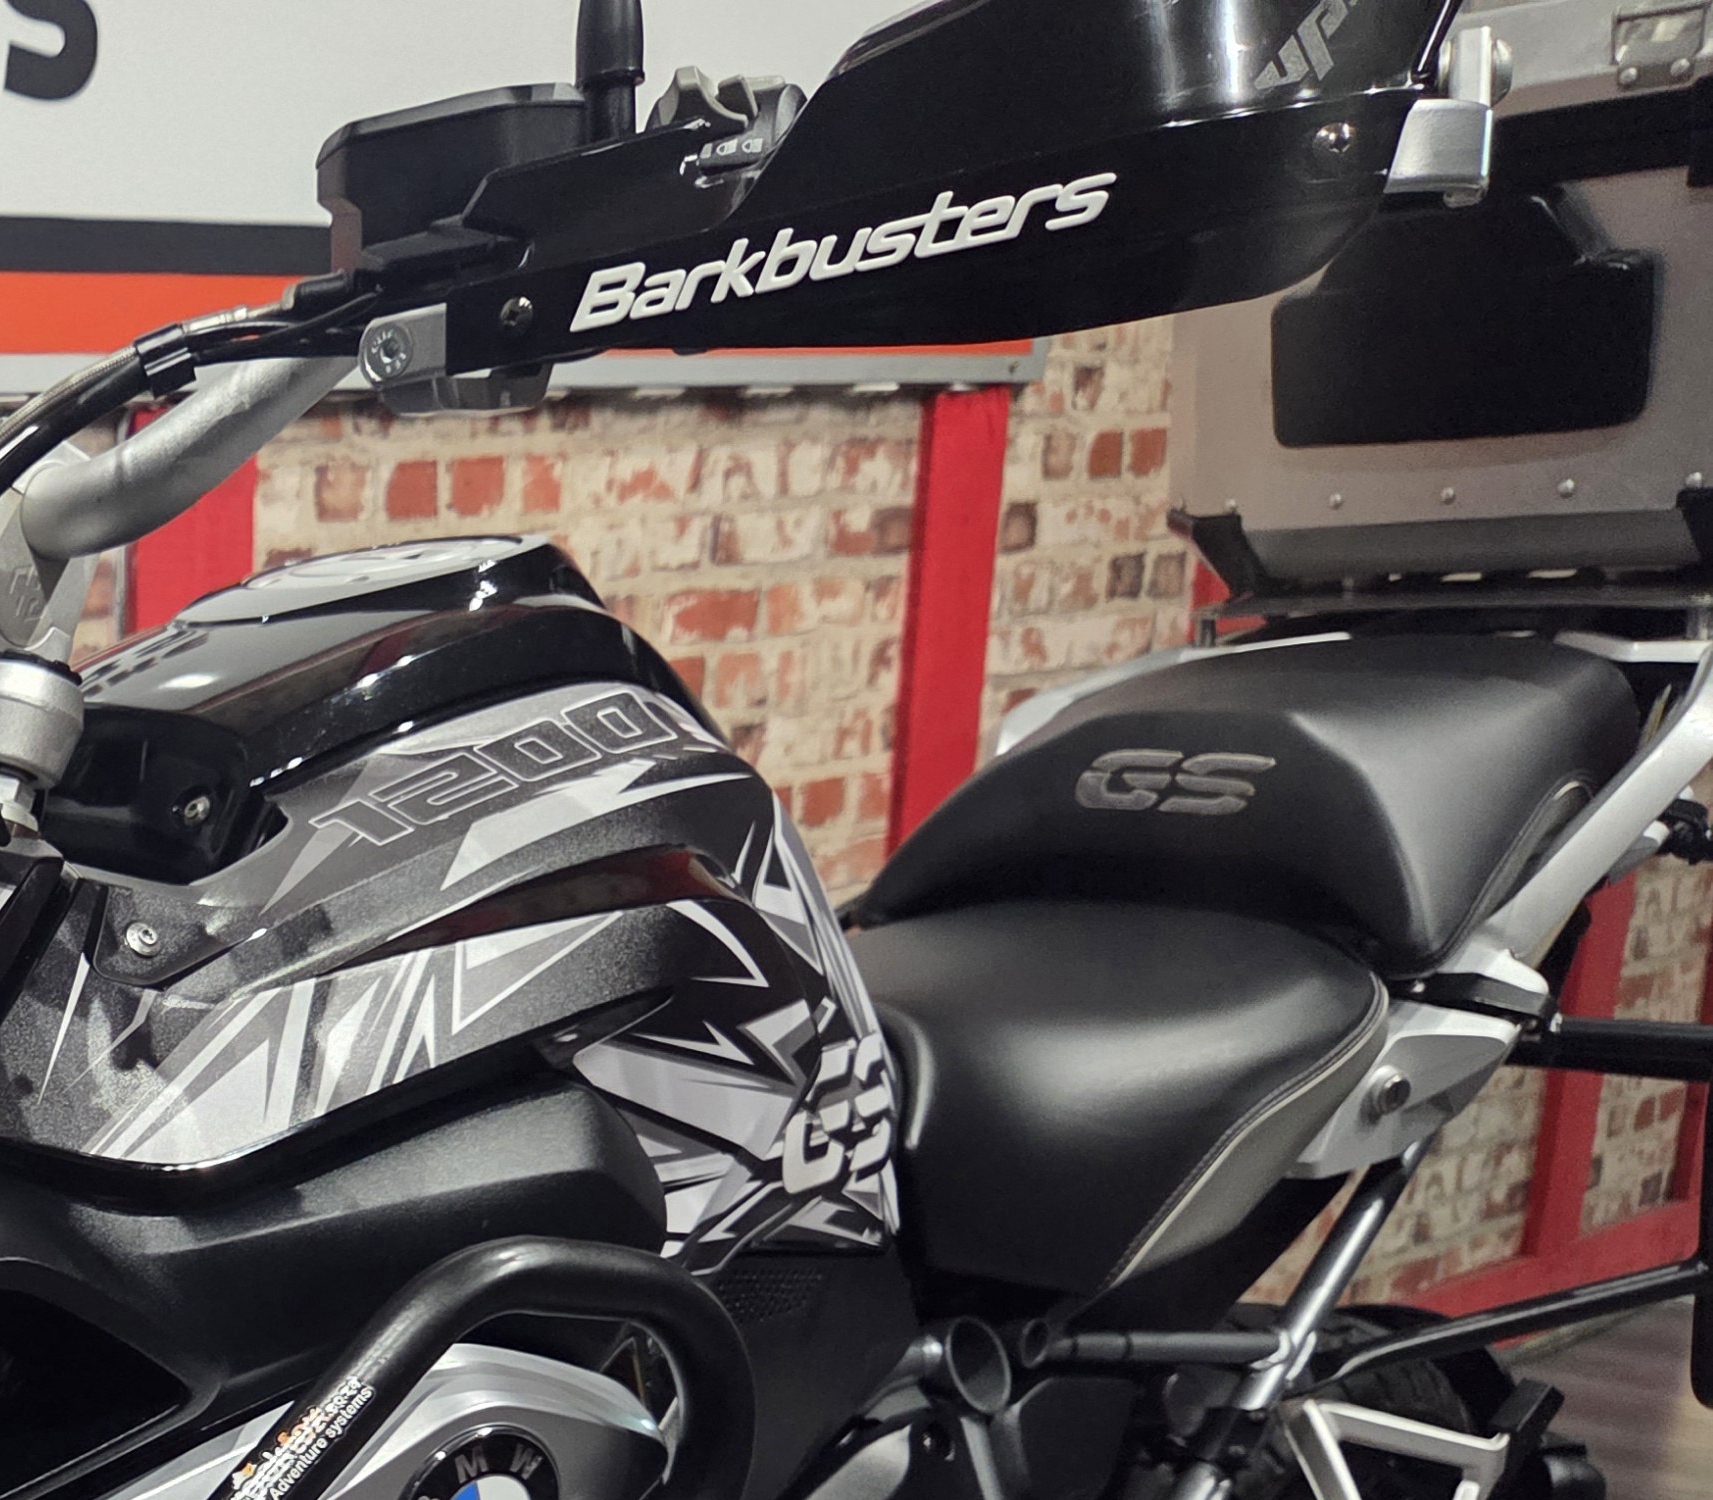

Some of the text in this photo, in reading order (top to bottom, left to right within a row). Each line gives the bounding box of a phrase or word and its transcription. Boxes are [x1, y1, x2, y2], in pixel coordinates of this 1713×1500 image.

[570, 172, 1118, 332] Barkbusters
[308, 690, 678, 846] 1200
[1074, 747, 1277, 816] GS
[782, 1033, 892, 1195] GS
[324, 1384, 375, 1441] systems
